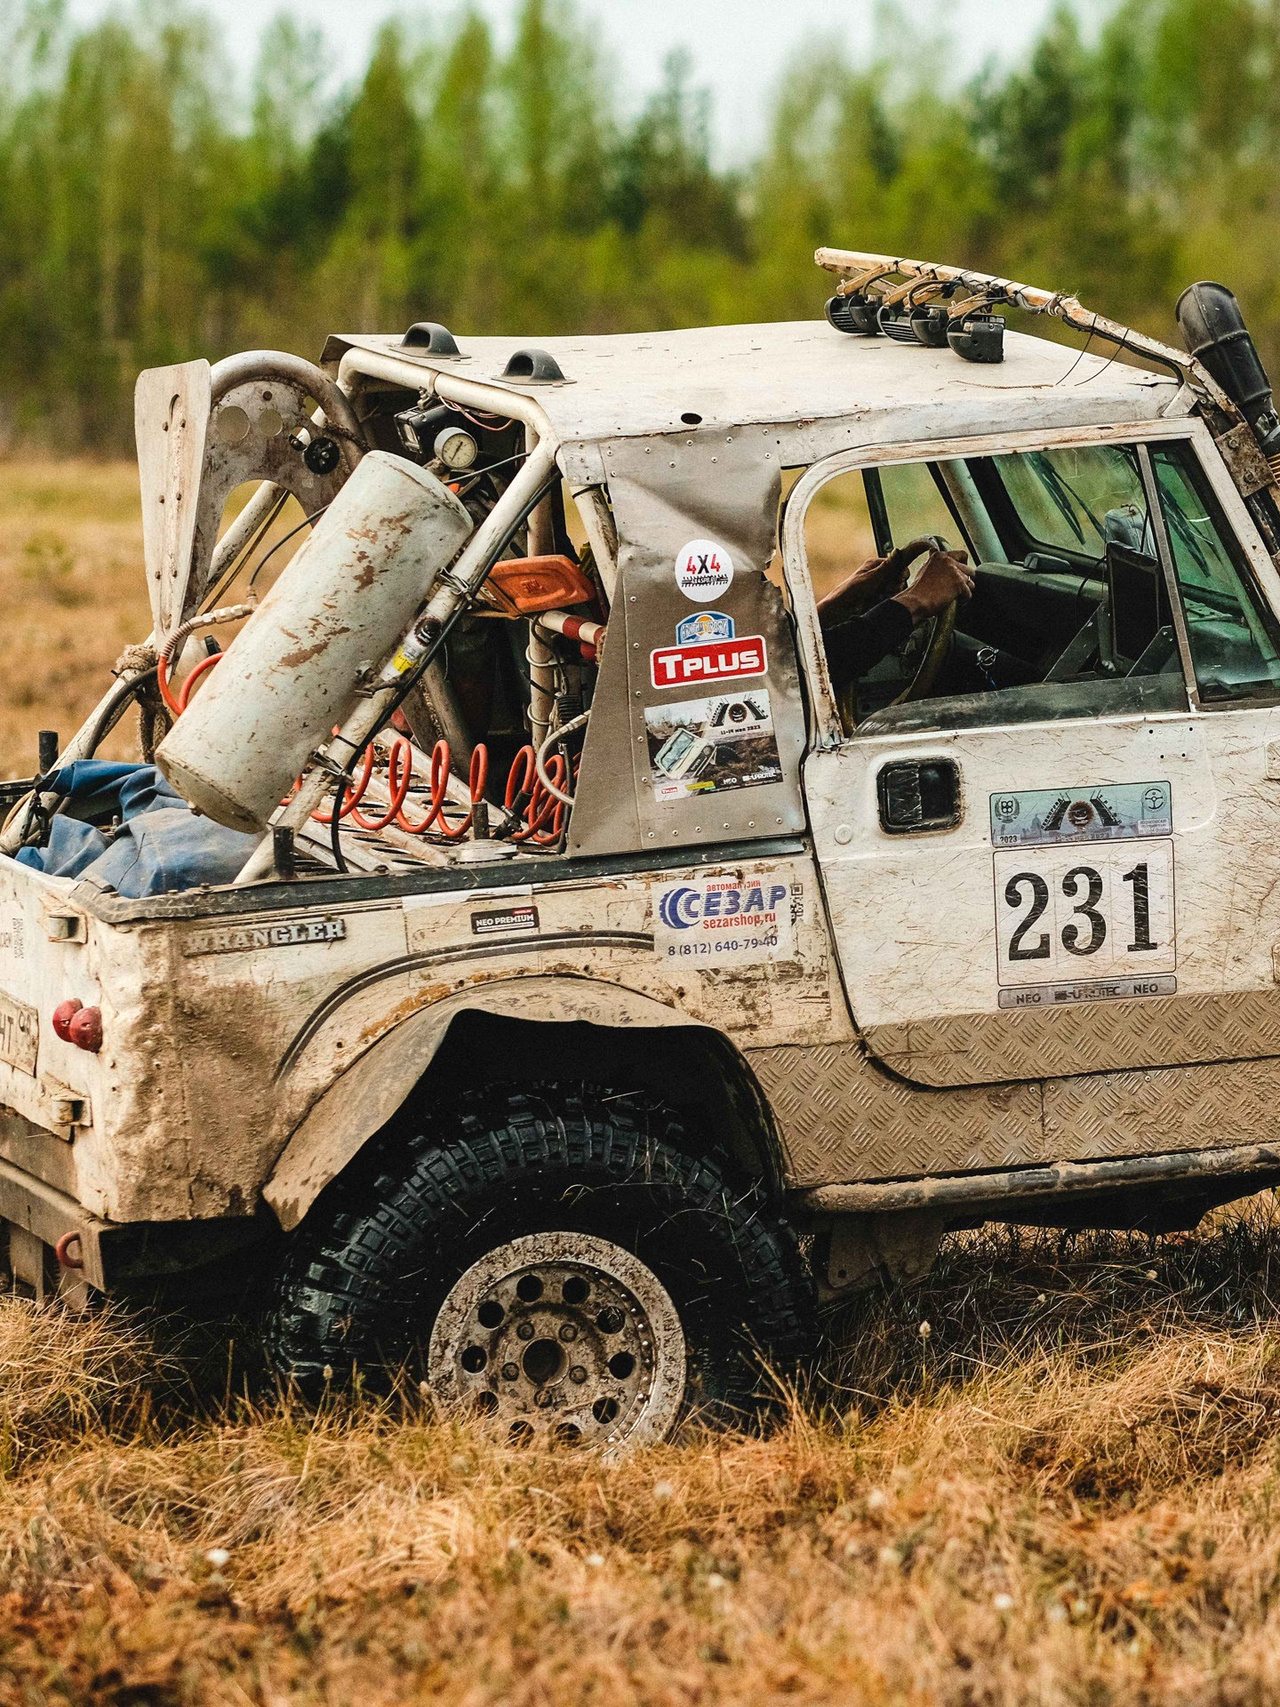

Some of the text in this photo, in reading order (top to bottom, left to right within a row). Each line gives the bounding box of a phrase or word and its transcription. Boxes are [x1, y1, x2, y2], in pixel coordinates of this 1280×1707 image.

[658, 649, 760, 679] TPLUS
[1000, 835, 1018, 845] 2023
[684, 885, 787, 918] СЕЗАР
[1005, 863, 1158, 961] 231
[475, 917, 494, 928] NEO
[495, 913, 535, 926] PREMIUM
[187, 921, 346, 950] WRANGLER
[668, 935, 778, 956] 8 (812) 640-79-40
[1016, 993, 1042, 1005] NEO
[1133, 983, 1159, 995] NEO
